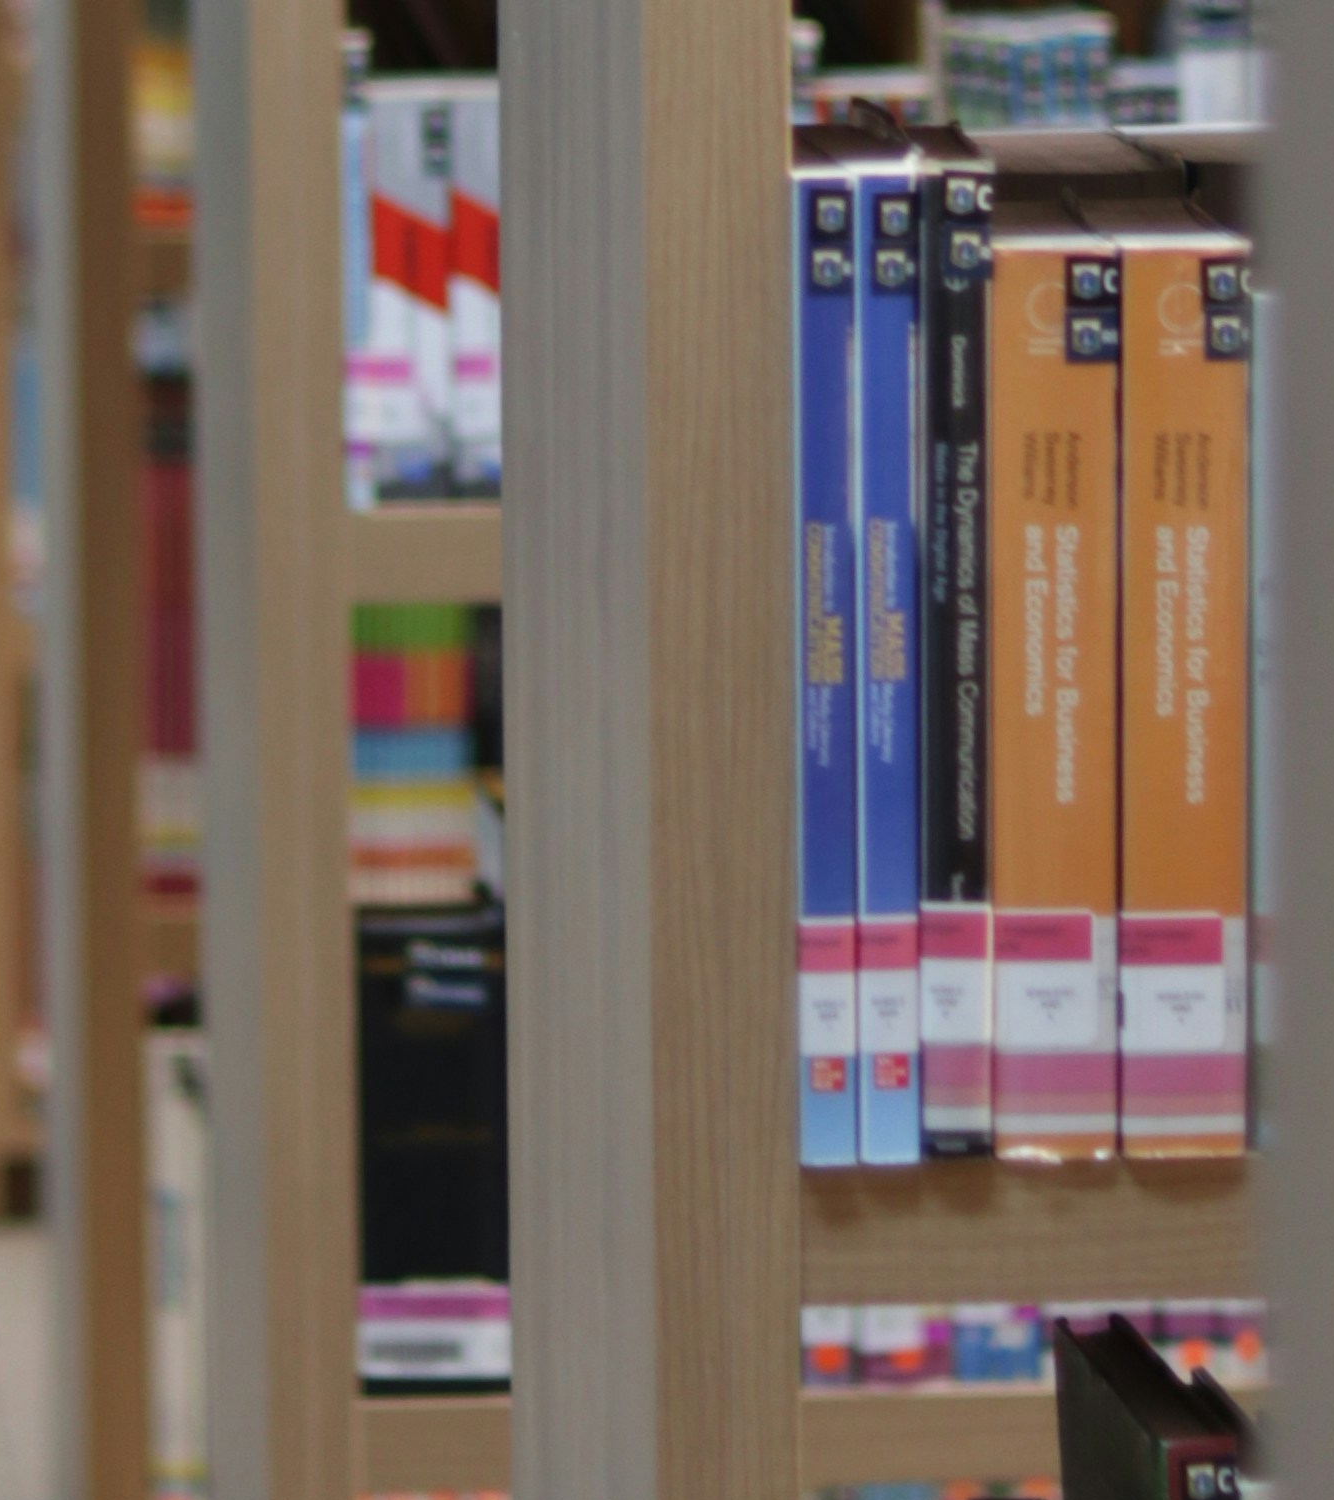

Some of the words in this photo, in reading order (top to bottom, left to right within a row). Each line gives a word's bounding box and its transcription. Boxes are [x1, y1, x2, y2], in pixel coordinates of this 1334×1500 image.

[957, 441, 979, 482] The
[952, 487, 980, 590] Dynamics
[1025, 524, 1044, 573] and
[1155, 525, 1177, 573] and
[957, 592, 979, 617] of
[1055, 524, 1079, 640] Statistics
[1185, 524, 1210, 641] Statistics
[822, 614, 843, 685] MASS
[886, 611, 906, 682] MASS
[957, 619, 979, 676] Mass
[1025, 577, 1048, 717] Economics
[1055, 645, 1079, 683] for
[1155, 579, 1179, 717] Economics
[1185, 646, 1210, 683] for
[957, 679, 979, 841] Communication
[1055, 688, 1079, 804] Business
[1185, 688, 1210, 805] Business
